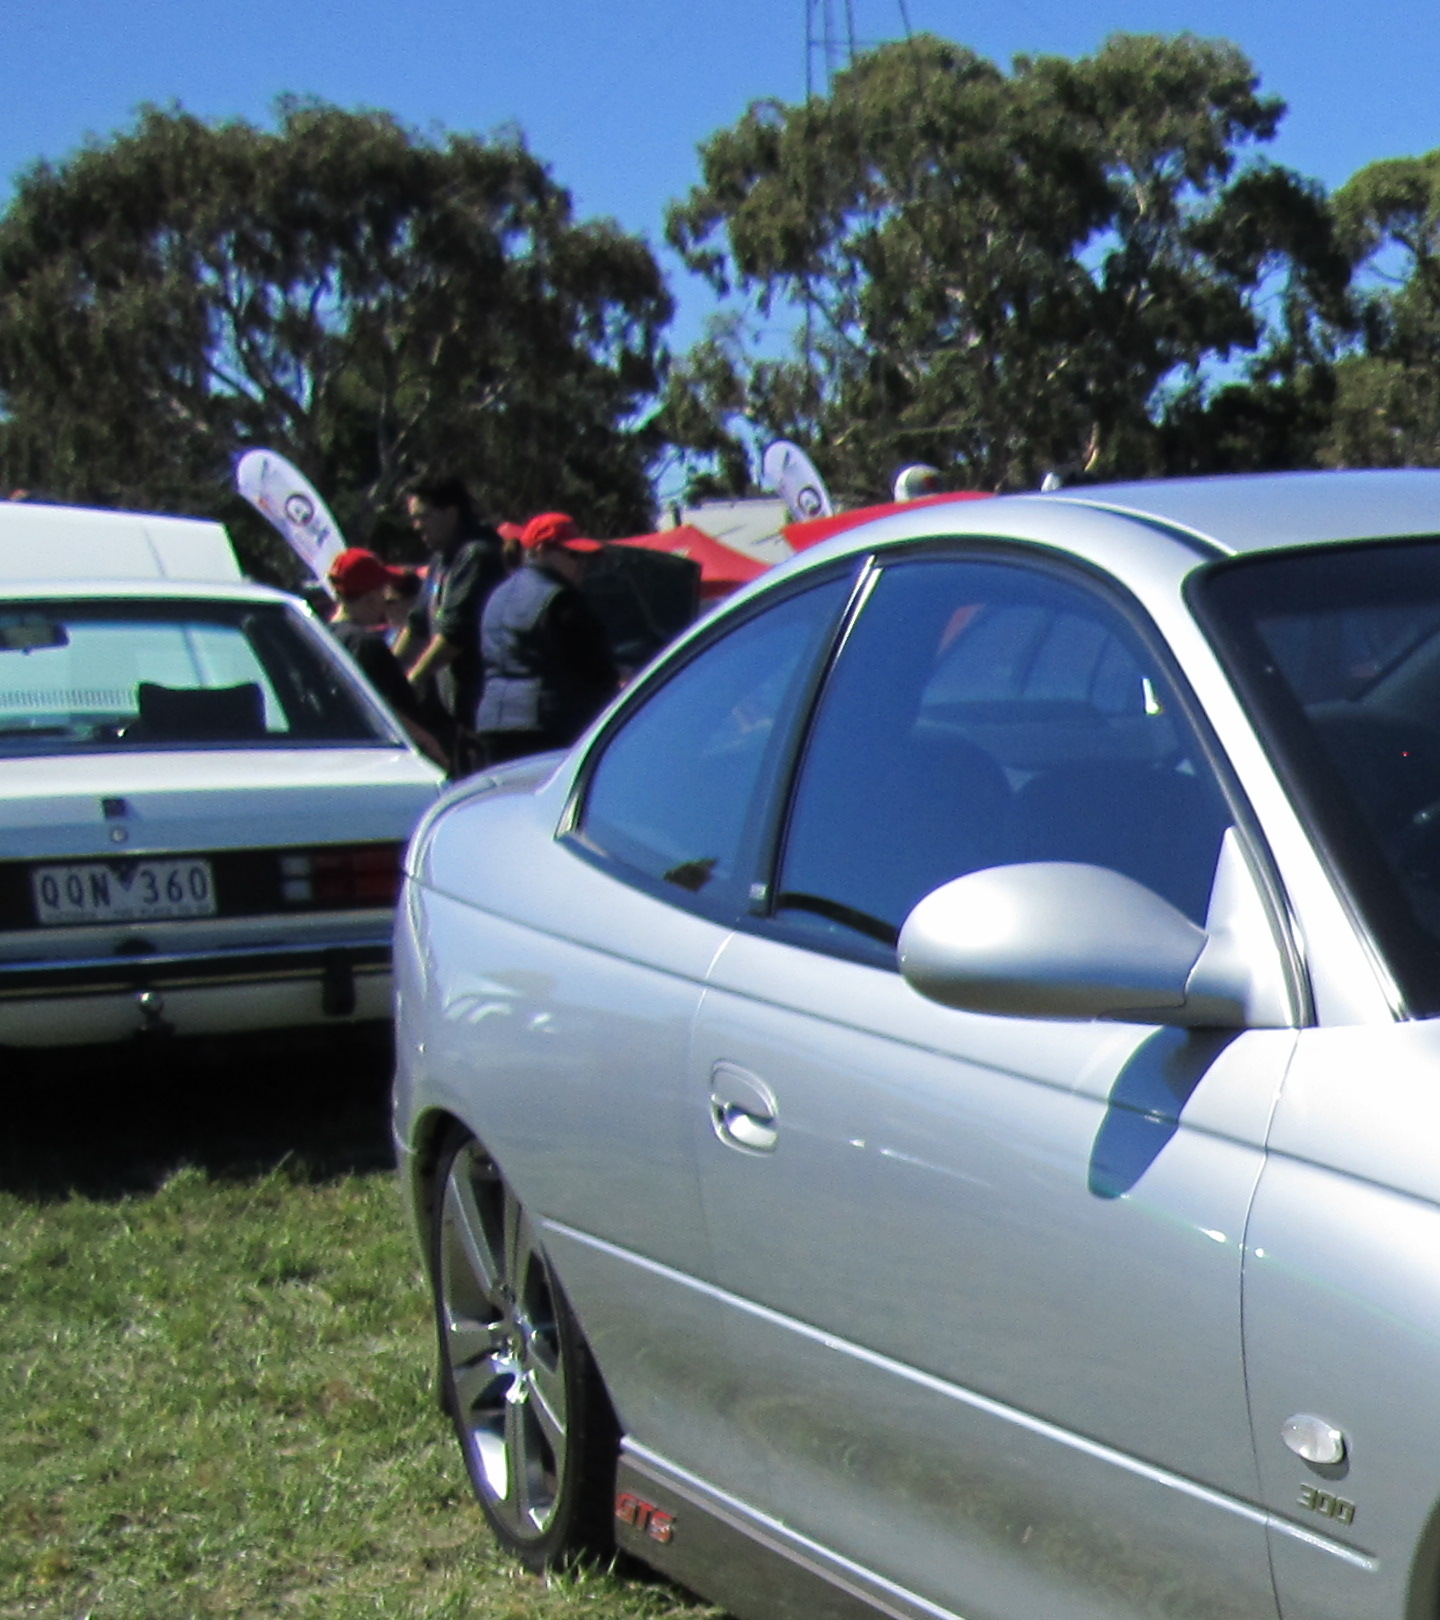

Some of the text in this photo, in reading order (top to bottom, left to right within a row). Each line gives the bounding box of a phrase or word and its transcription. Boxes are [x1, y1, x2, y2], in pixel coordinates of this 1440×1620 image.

[42, 866, 207, 909] QQN 360
[615, 1493, 675, 1543] GTS
[1296, 1482, 1357, 1527] 300
